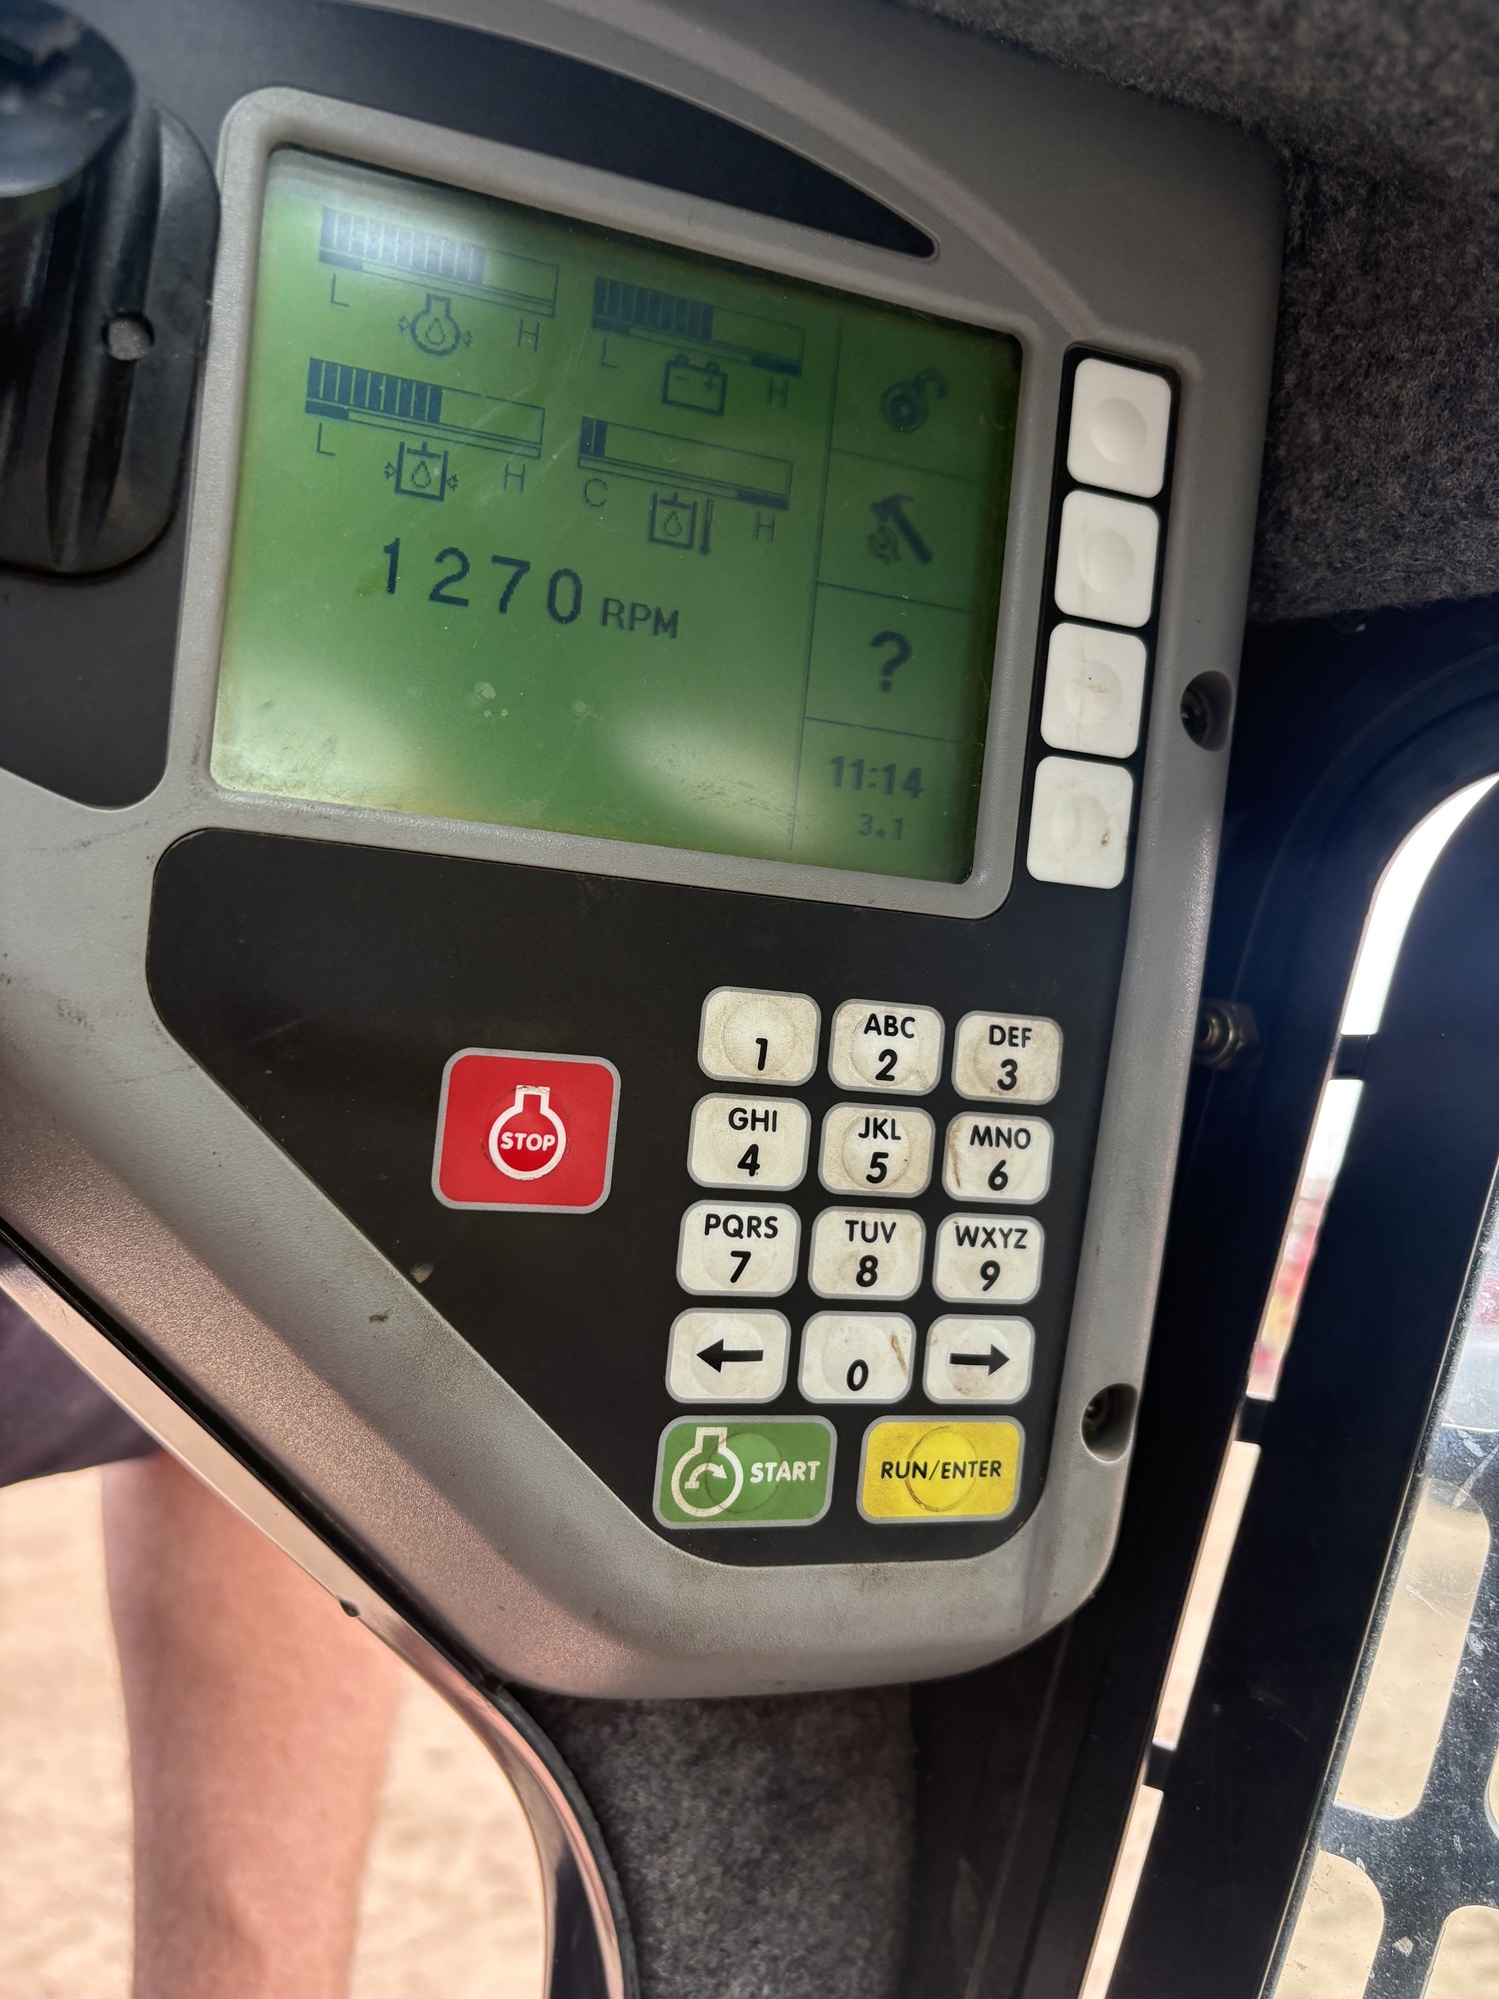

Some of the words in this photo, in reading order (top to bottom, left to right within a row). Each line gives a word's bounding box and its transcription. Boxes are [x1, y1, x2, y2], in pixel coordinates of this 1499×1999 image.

[331, 273, 350, 307] L
[517, 318, 541, 351] H
[602, 338, 619, 369] L
[768, 377, 790, 409] H
[316, 422, 336, 456] L
[503, 462, 526, 494] H
[584, 478, 608, 508] C
[754, 511, 777, 543] H
[382, 537, 584, 625] 1270
[601, 596, 680, 640] RPM
[831, 755, 925, 799] 11:14
[859, 812, 904, 841] 3.1
[863, 1013, 916, 1039] ABC
[988, 1024, 1033, 1048] DEF
[755, 1037, 769, 1071] 1
[875, 1048, 898, 1082] 2
[997, 1058, 1018, 1091] 3
[728, 1107, 778, 1133] GHI
[858, 1116, 902, 1141] JKL
[500, 1131, 556, 1152] STOP
[969, 1124, 1031, 1150] MNO
[737, 1144, 760, 1177] 4
[865, 1151, 889, 1184] 5
[987, 1159, 1009, 1191] 6
[704, 1213, 778, 1240] PQRS
[845, 1219, 897, 1244] TUV
[954, 1225, 1029, 1250] WXYZ
[730, 1250, 752, 1284] 7
[856, 1254, 879, 1288] 8
[980, 1259, 1001, 1292] 9
[846, 1359, 869, 1392] 0
[750, 1460, 821, 1484] START
[880, 1459, 1002, 1481] RUN/ENTER
